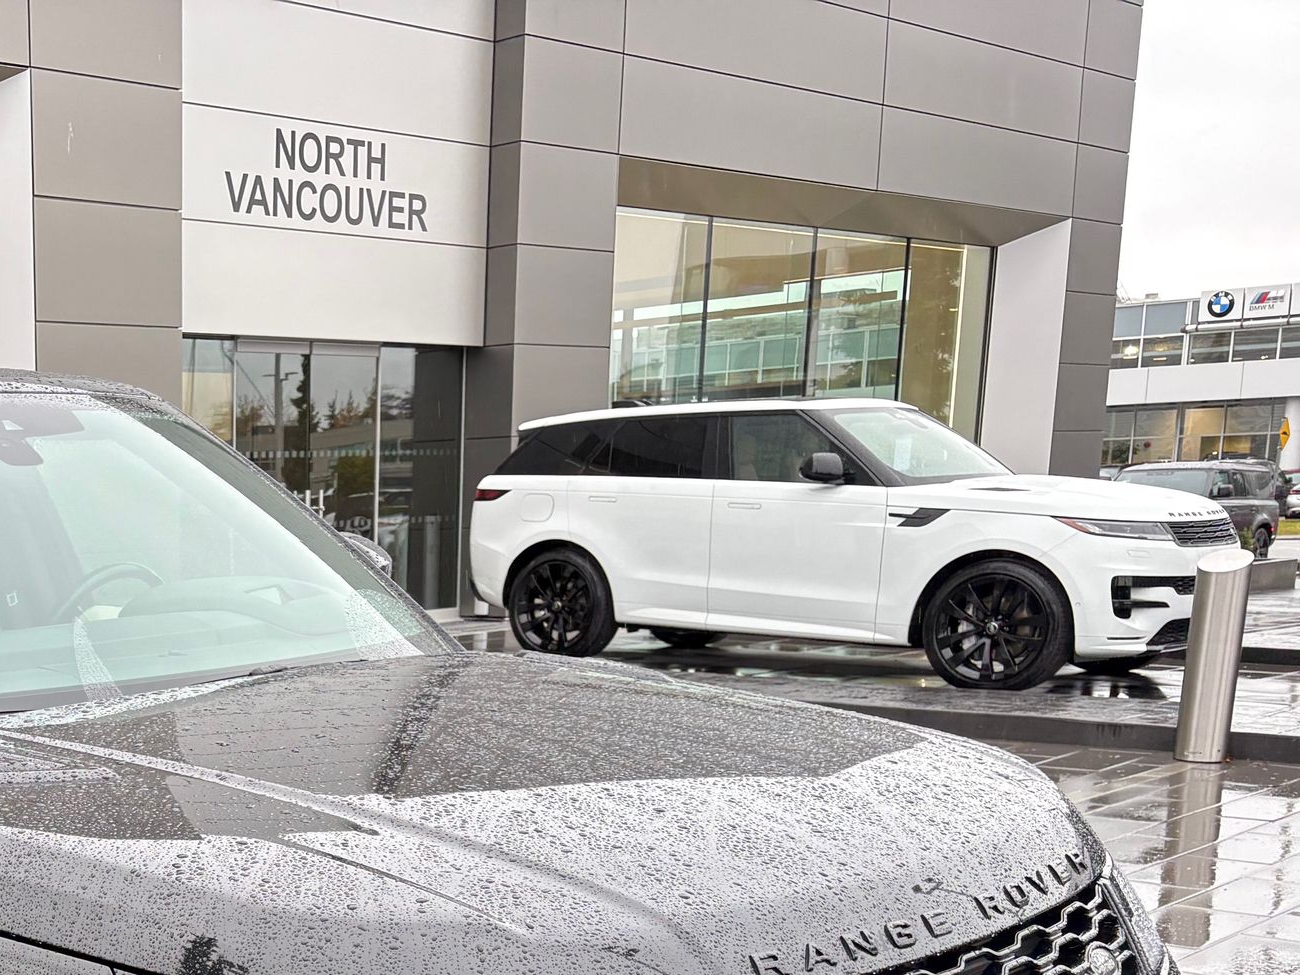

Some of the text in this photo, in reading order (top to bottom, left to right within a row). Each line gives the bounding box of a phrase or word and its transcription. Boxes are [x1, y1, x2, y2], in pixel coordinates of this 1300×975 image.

[275, 127, 386, 182] NORTH
[224, 170, 428, 233] VANCOUVER
[974, 849, 1091, 920] ROVER
